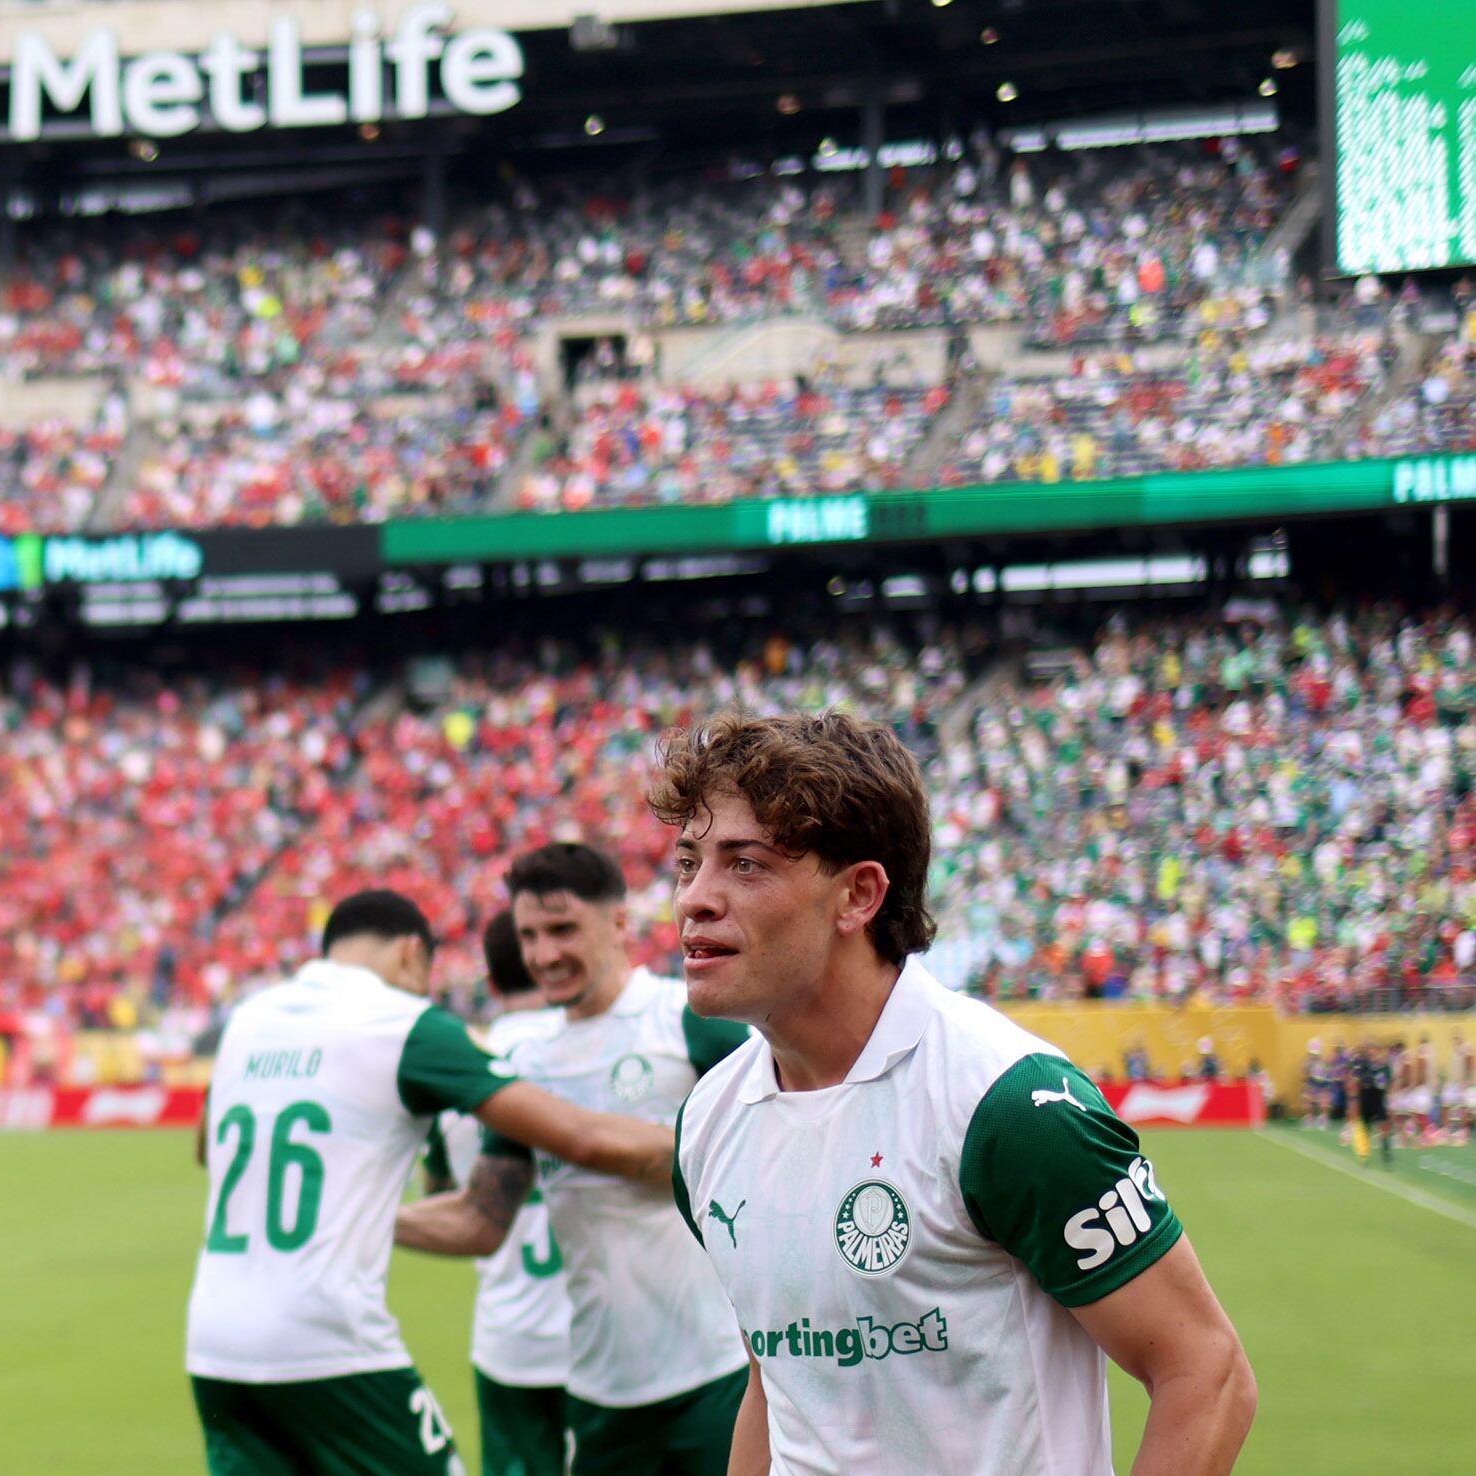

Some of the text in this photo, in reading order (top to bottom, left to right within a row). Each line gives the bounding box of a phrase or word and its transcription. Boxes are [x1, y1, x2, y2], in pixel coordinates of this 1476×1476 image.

[8, 6, 524, 142] MetLife
[245, 1048, 323, 1080] MURILO
[206, 1099, 333, 1254] 26
[837, 1220, 909, 1271] PALMEIRAS
